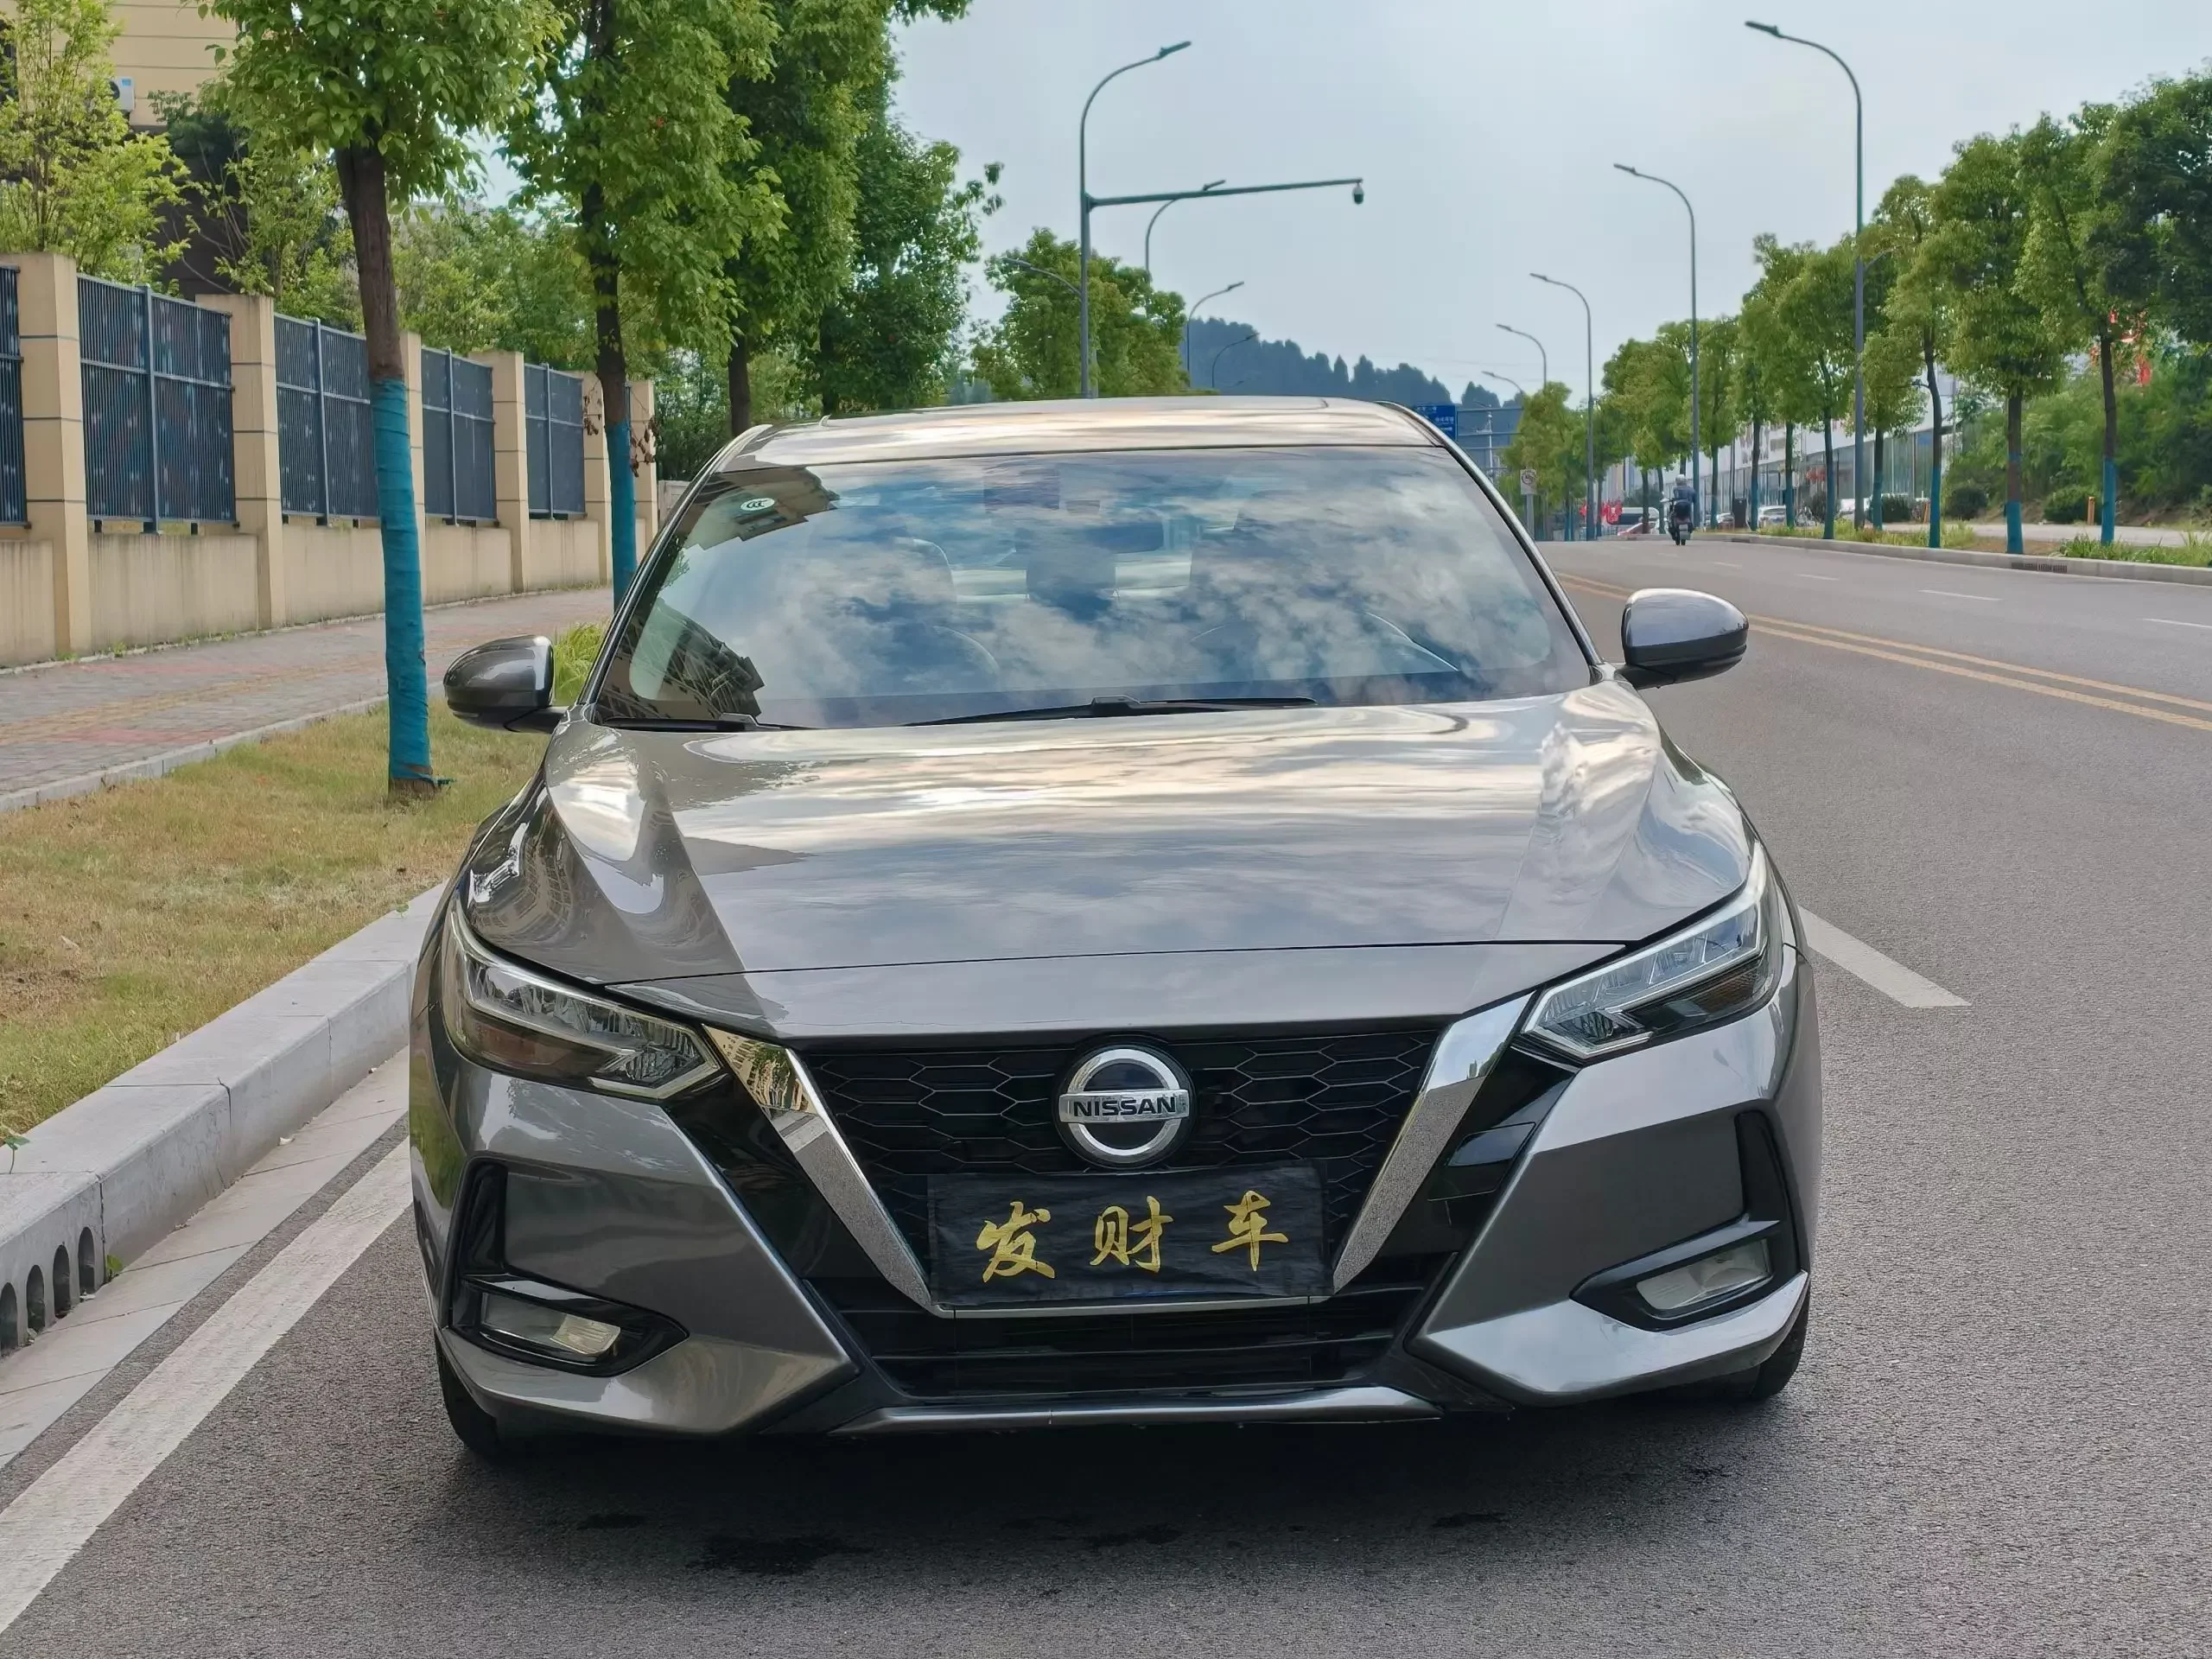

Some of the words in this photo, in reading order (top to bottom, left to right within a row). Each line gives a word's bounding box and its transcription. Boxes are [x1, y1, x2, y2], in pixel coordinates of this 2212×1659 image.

[1073, 1096, 1176, 1117] NISSAN
[976, 1190, 1289, 1283] 发财车
